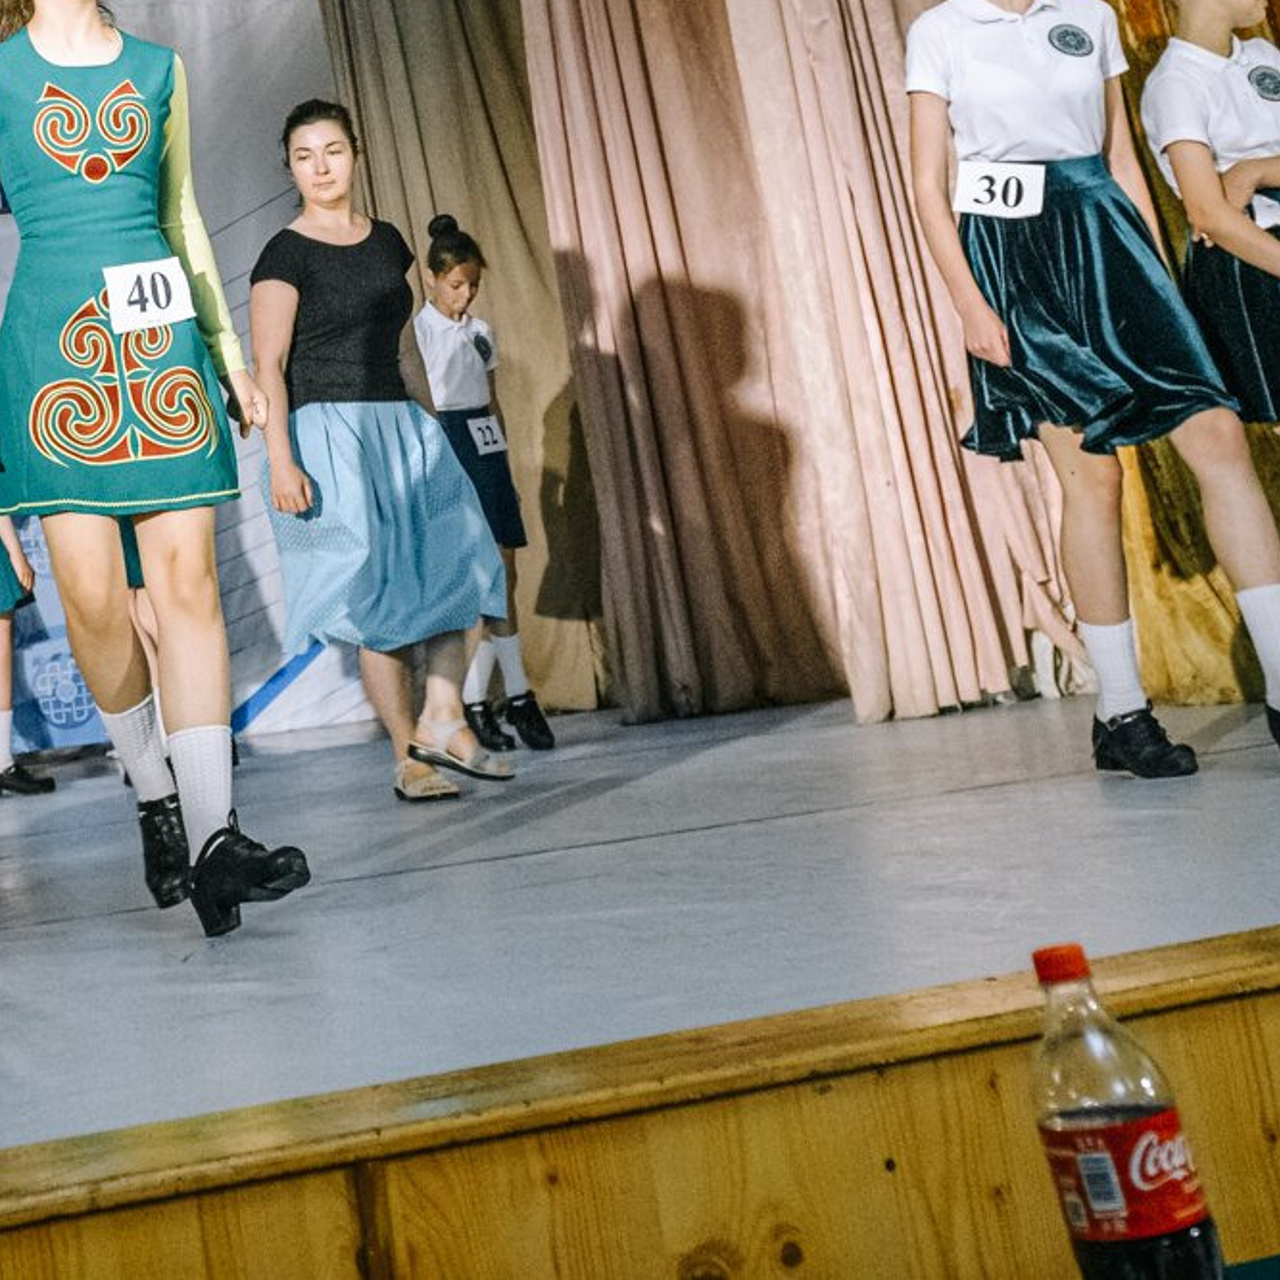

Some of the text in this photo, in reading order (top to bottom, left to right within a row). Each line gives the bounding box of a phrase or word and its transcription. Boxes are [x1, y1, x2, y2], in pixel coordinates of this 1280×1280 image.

[972, 175, 1024, 208] 30
[127, 271, 171, 313] 40
[476, 424, 499, 447] 22
